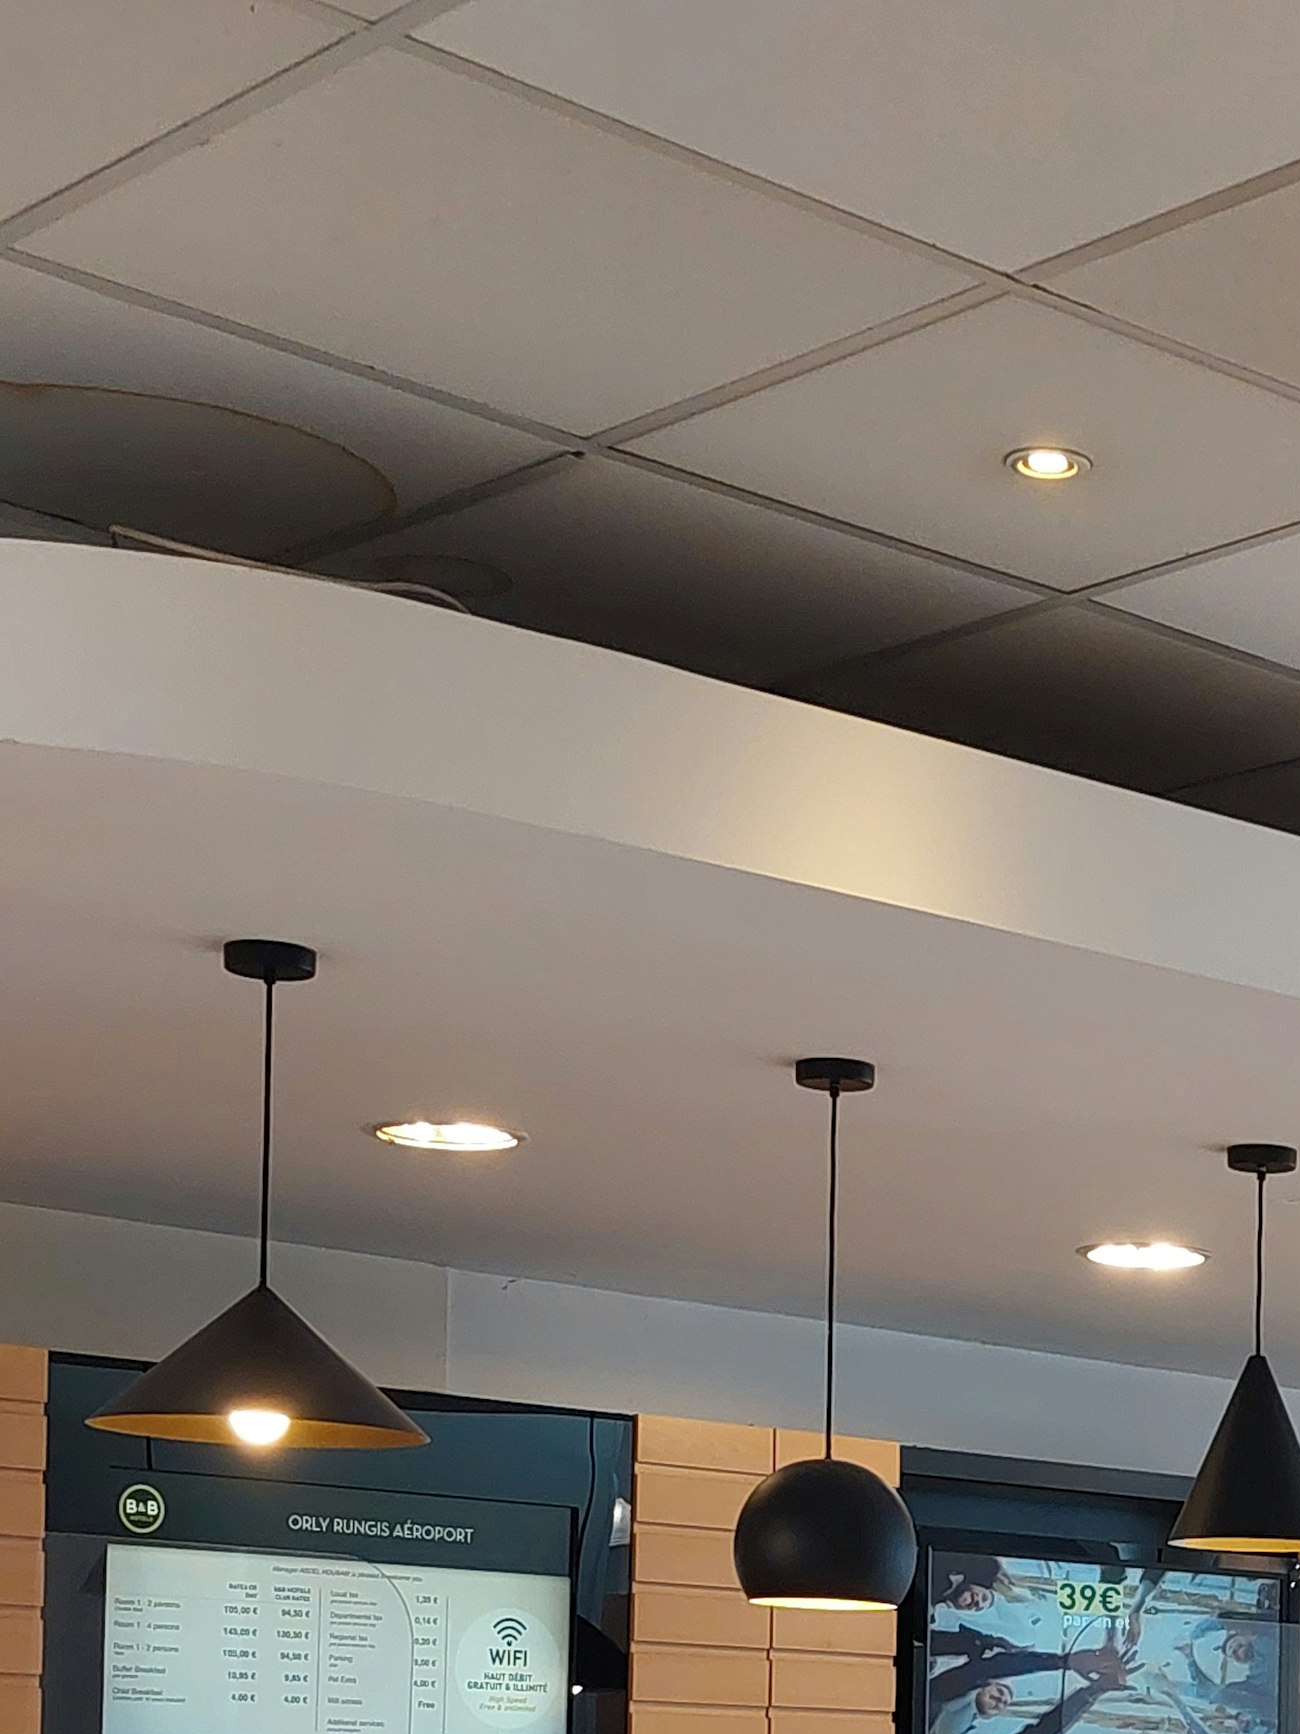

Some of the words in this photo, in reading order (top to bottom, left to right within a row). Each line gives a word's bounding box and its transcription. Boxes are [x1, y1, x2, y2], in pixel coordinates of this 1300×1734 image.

[126, 1499, 159, 1516] B&B
[288, 1514, 330, 1532] ORLY
[333, 1518, 390, 1537] RUNGIS
[393, 1520, 474, 1544] AÉROPORT
[1059, 1583, 1121, 1613] 39€
[489, 1648, 528, 1667] WIFI
[467, 1681, 503, 1690] GRATUIT
[484, 1672, 506, 1681] HAUT
